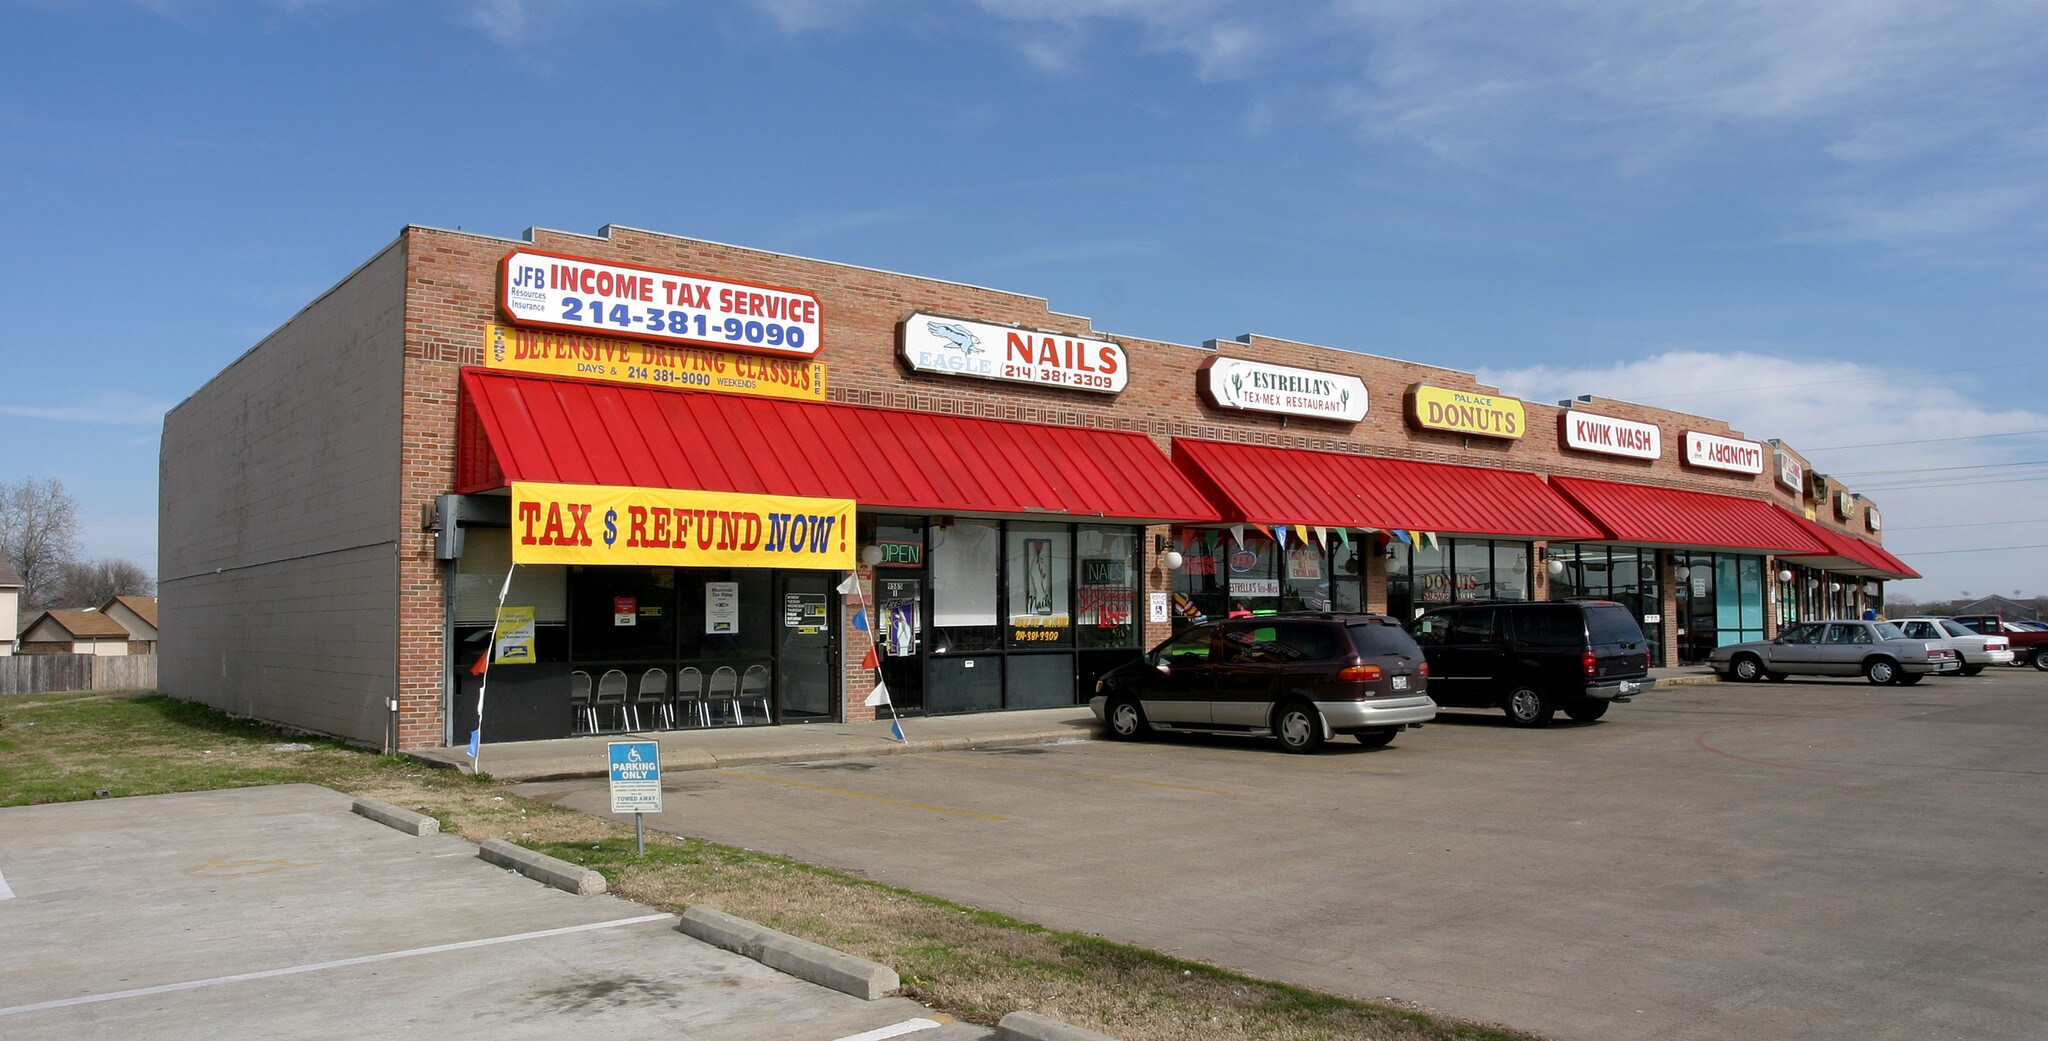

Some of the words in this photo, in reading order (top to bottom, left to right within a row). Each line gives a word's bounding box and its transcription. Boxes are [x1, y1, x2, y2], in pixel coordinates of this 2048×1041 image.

[513, 265, 545, 289] JFB
[511, 287, 546, 300] Resources
[551, 264, 653, 302] INCOME
[663, 280, 711, 310] TAX
[720, 288, 815, 324] SERVICE
[511, 300, 545, 312] Insurance
[561, 297, 805, 348] 214-381-9090
[515, 328, 630, 363] DEFENSIVE
[642, 343, 726, 374] DRIVING
[735, 355, 810, 391] CLASSES
[919, 351, 992, 374] EAGLE
[1007, 332, 1118, 375] NAILS
[577, 363, 605, 375] DAYS
[610, 367, 618, 376] &
[628, 366, 648, 380] 214
[653, 368, 710, 386] 381-9090
[717, 377, 757, 389] WEEKENDS
[1000, 362, 1037, 382] (214)
[1253, 371, 1330, 396] ESTRELLA'S
[1286, 396, 1340, 412] RESTAURANT
[1454, 393, 1492, 407] PALACE
[1428, 401, 1516, 434] DONUTS
[1576, 419, 1612, 446] KWIK
[1616, 427, 1651, 452] WASH
[1708, 441, 1760, 468] LAUNDRY
[519, 501, 593, 548] TAX
[603, 506, 617, 549] $
[627, 505, 762, 552] REFUND
[879, 544, 919, 563] OPEN
[612, 762, 656, 771] PARKING
[622, 771, 648, 779] ONLY
